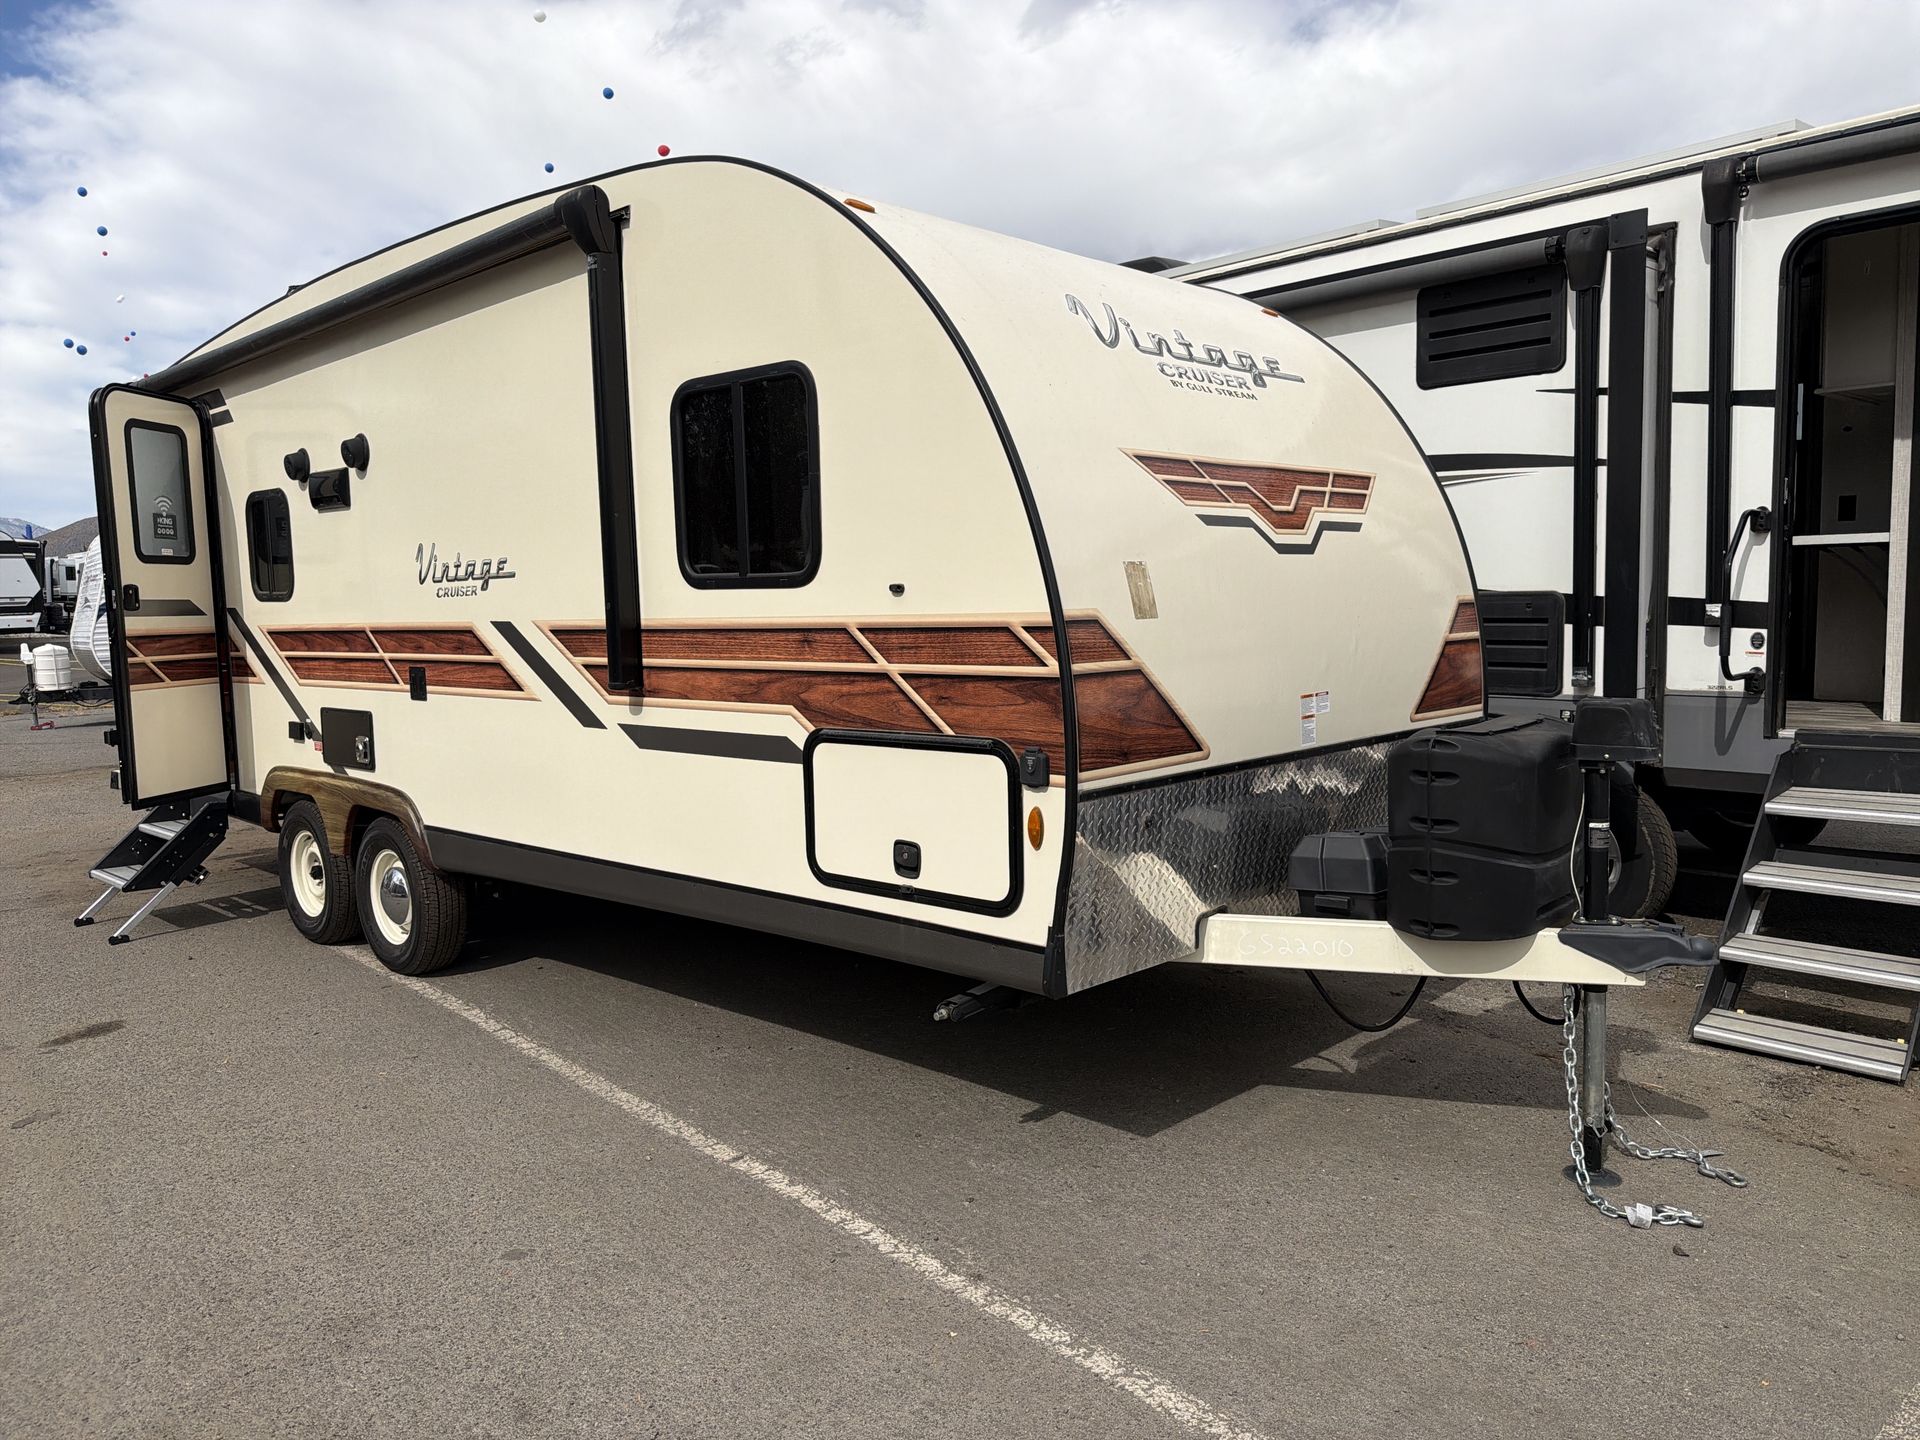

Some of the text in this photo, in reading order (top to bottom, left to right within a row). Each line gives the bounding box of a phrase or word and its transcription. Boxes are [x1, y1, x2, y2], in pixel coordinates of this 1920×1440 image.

[1065, 293, 1305, 389] Vintage
[1157, 362, 1252, 390] CRUISER
[1170, 379, 1185, 389] BY
[1214, 387, 1259, 401] STREAM
[415, 542, 516, 591] Vintage
[436, 585, 478, 598] CRUISER
